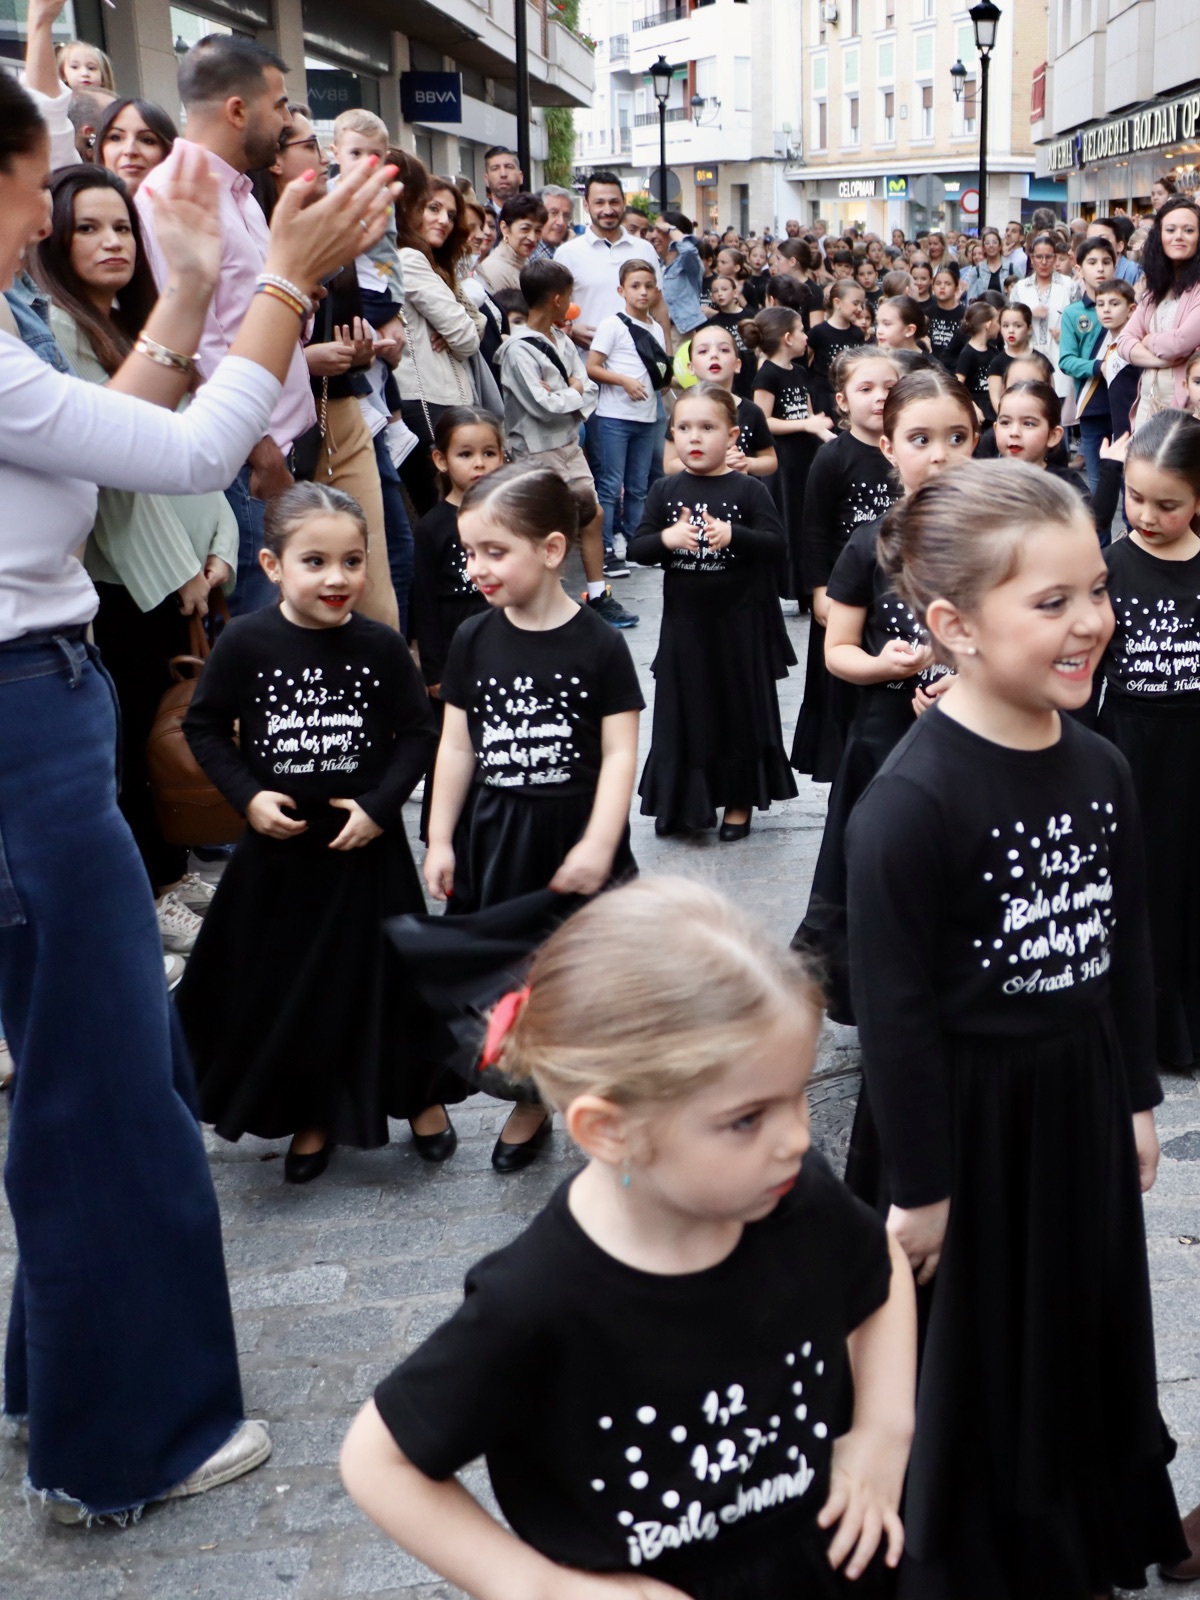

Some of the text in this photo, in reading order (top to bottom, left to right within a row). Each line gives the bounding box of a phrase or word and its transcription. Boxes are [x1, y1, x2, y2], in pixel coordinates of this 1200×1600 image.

[415, 91, 457, 104] BBVA
[1082, 119, 1130, 163] RELOJERIA
[1133, 104, 1179, 151] ROLDAN
[877, 484, 888, 494] 1,2
[1157, 599, 1175, 614] 1,2
[1126, 635, 1158, 655] ¡Baila
[1160, 636, 1174, 651] el
[302, 668, 323, 684] 1,2
[1134, 654, 1200, 676] con los pies!
[513, 677, 534, 693] 1,2
[267, 708, 363, 736] ¡Baila el mundo
[277, 730, 353, 754] con los pies!
[273, 755, 360, 774] Araceli Hidalgo
[487, 750, 511, 765] con
[1047, 814, 1073, 841] 1,2
[1003, 888, 1050, 933] ¡Baila
[1052, 881, 1071, 914] el
[1020, 935, 1050, 960] con
[1049, 920, 1075, 956] los
[1003, 963, 1074, 995] Araceli
[702, 1383, 748, 1426] 1,2
[626, 1500, 720, 1567] ¡Baila
